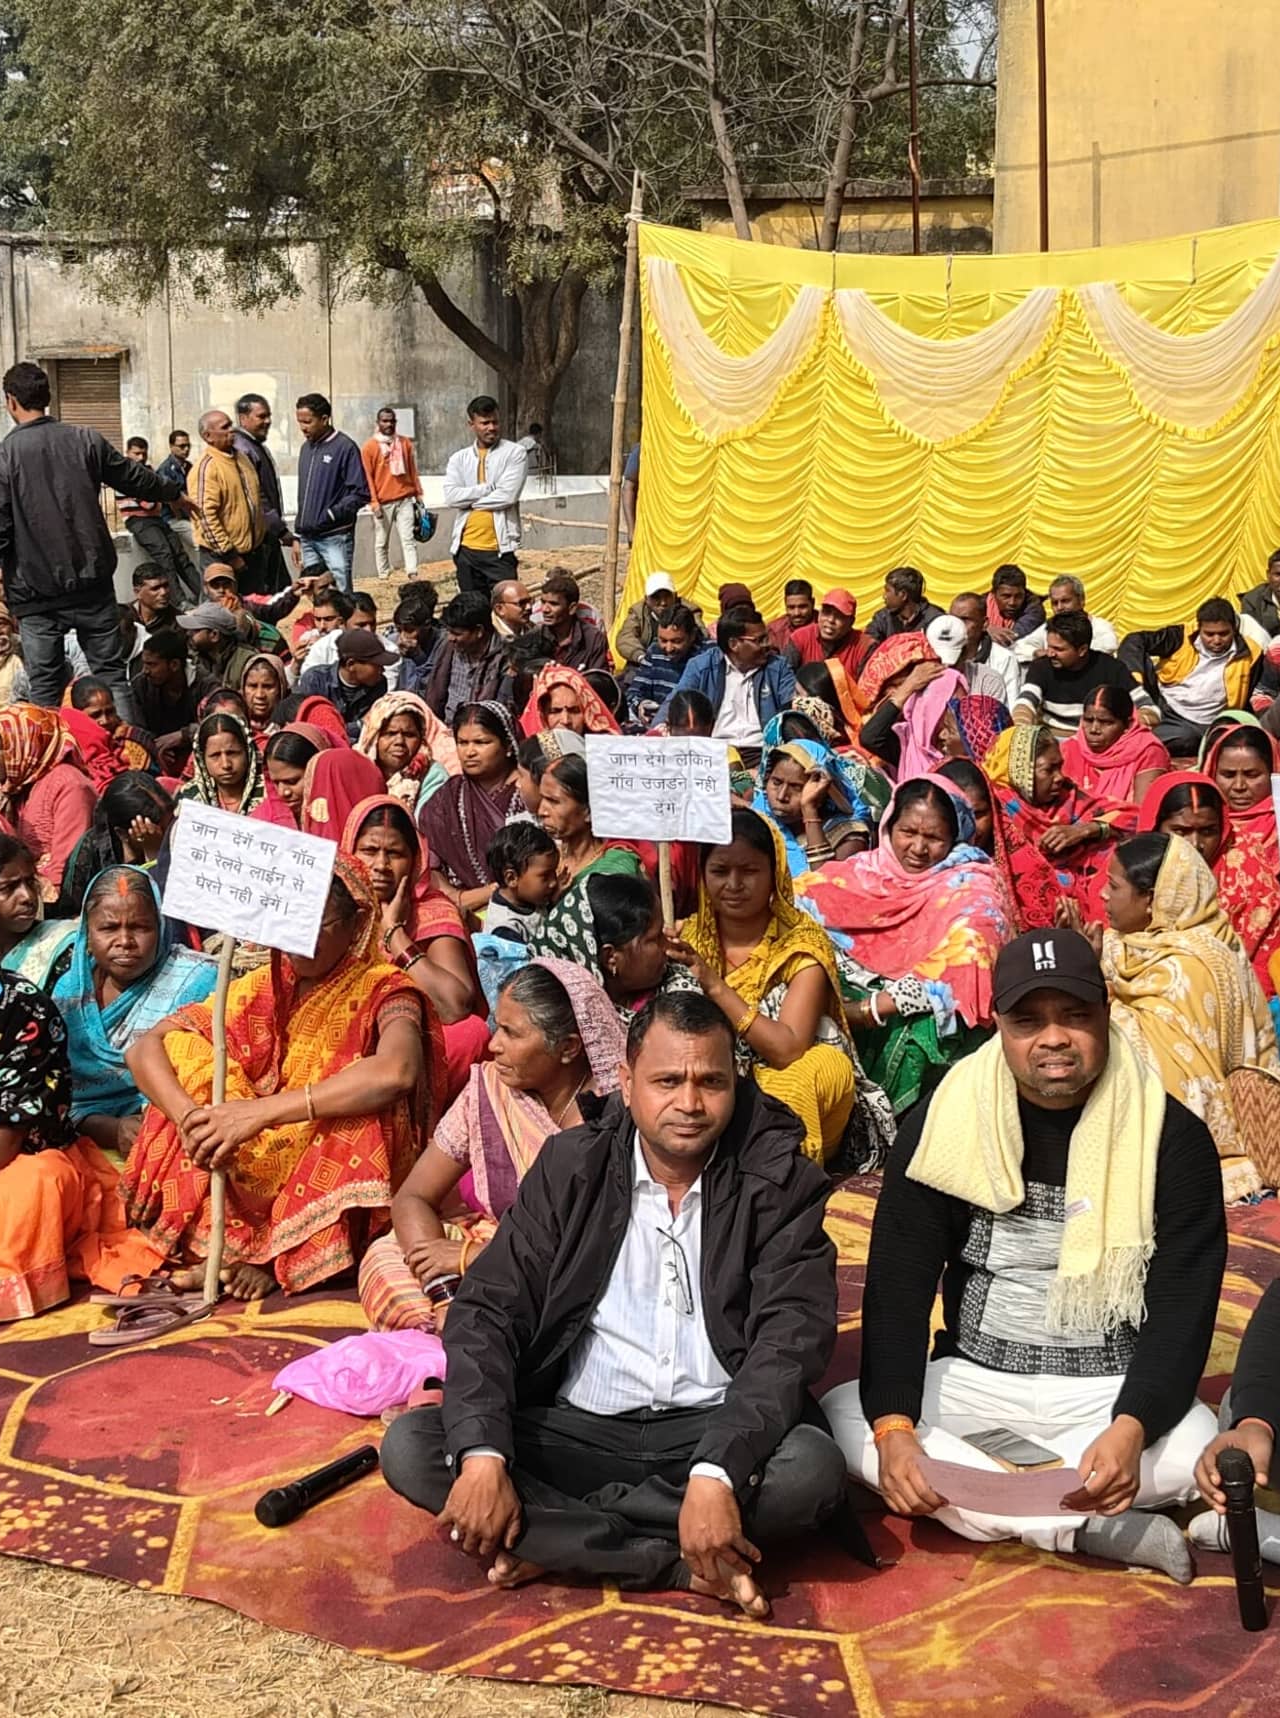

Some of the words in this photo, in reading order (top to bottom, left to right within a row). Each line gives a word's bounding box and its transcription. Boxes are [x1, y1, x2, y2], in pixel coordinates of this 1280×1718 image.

[608, 753, 637, 768] जान
[673, 749, 713, 769] लेकिन
[191, 820, 219, 840] जान
[260, 840, 279, 857] पर
[190, 845, 211, 864] को
[214, 849, 245, 875] रेलवे
[249, 865, 287, 887] लाईन
[293, 873, 305, 893] से
[194, 871, 223, 896] घेरने
[1035, 960, 1057, 972] BTS
